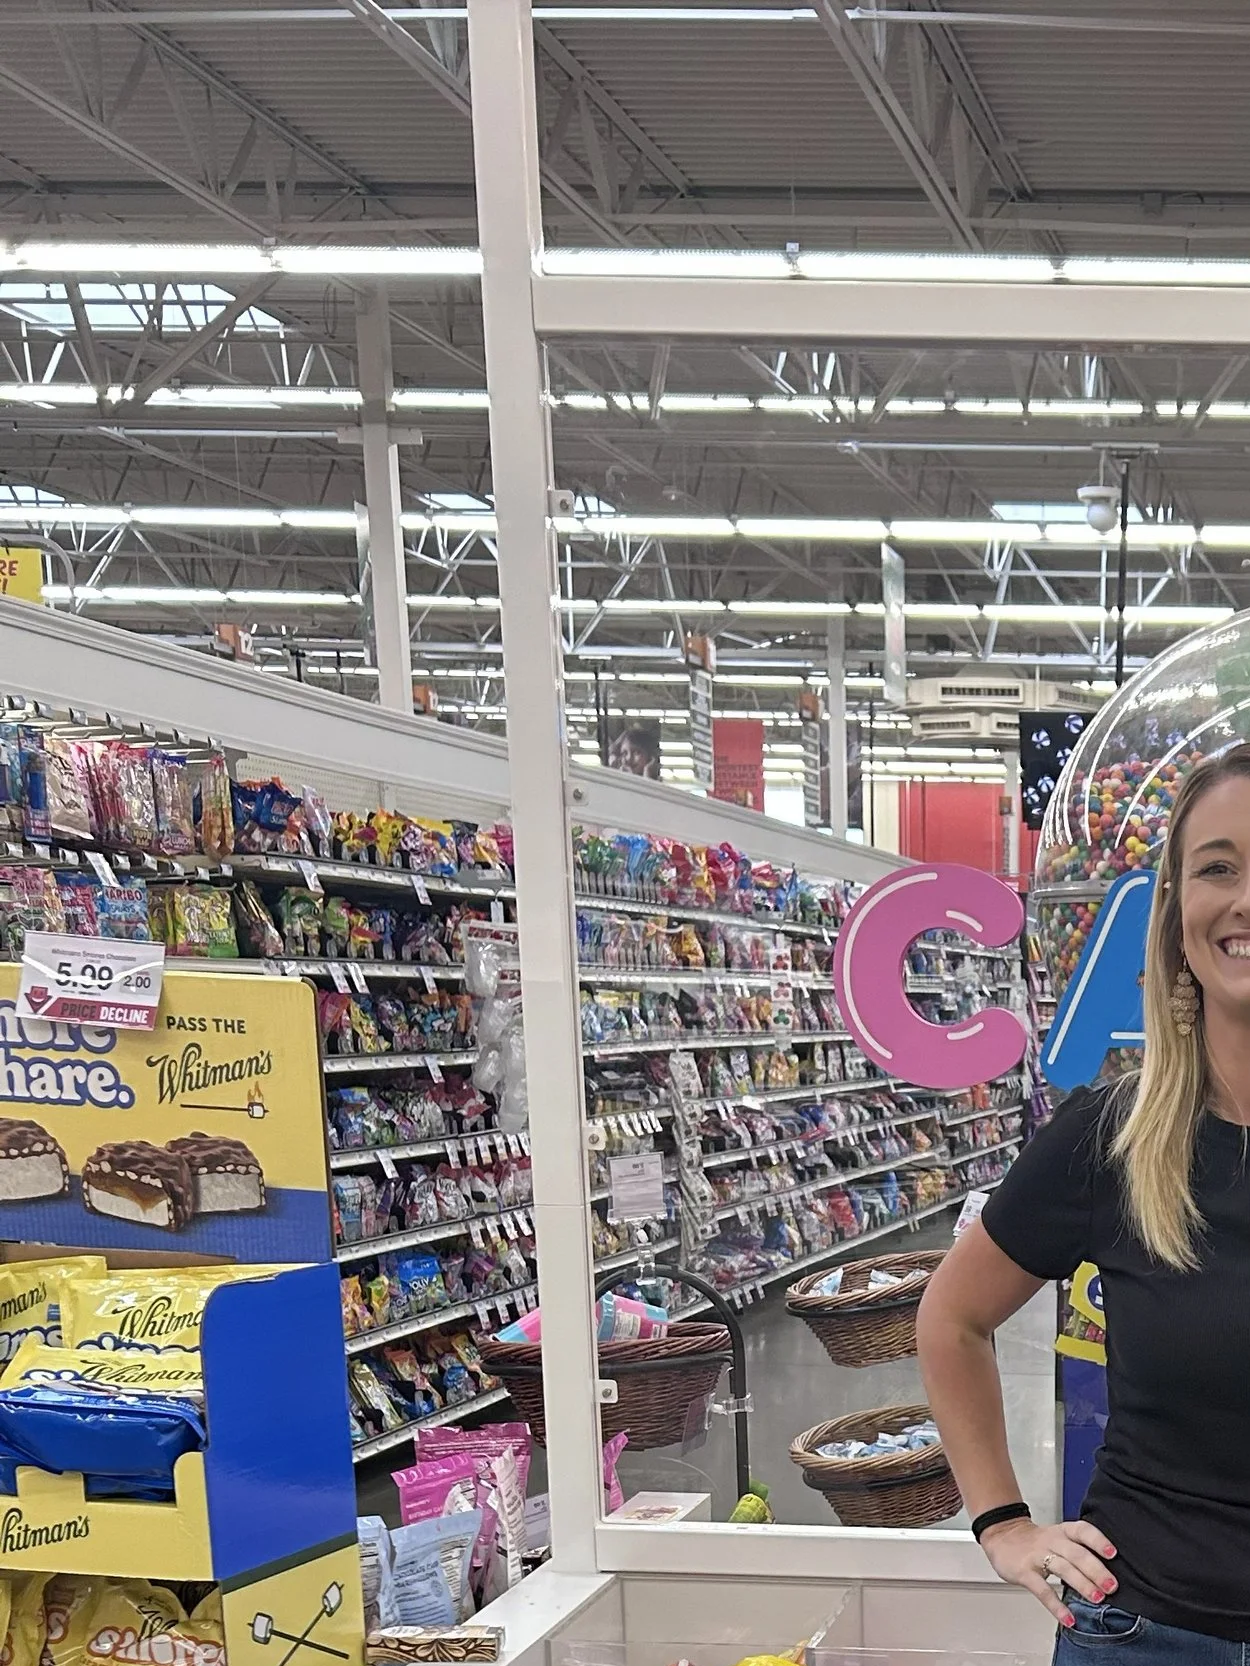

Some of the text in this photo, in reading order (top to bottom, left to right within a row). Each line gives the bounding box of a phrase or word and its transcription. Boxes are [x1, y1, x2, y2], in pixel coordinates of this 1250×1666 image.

[123, 974, 151, 989] 2.00
[60, 1002, 150, 1024] PRICE DECLINE
[166, 1016, 247, 1034] PASS THE
[0, 1051, 130, 1103] hare.
[147, 1043, 273, 1105] Whitman's
[0, 1281, 47, 1320] man's
[0, 1507, 90, 1553] hitman's
